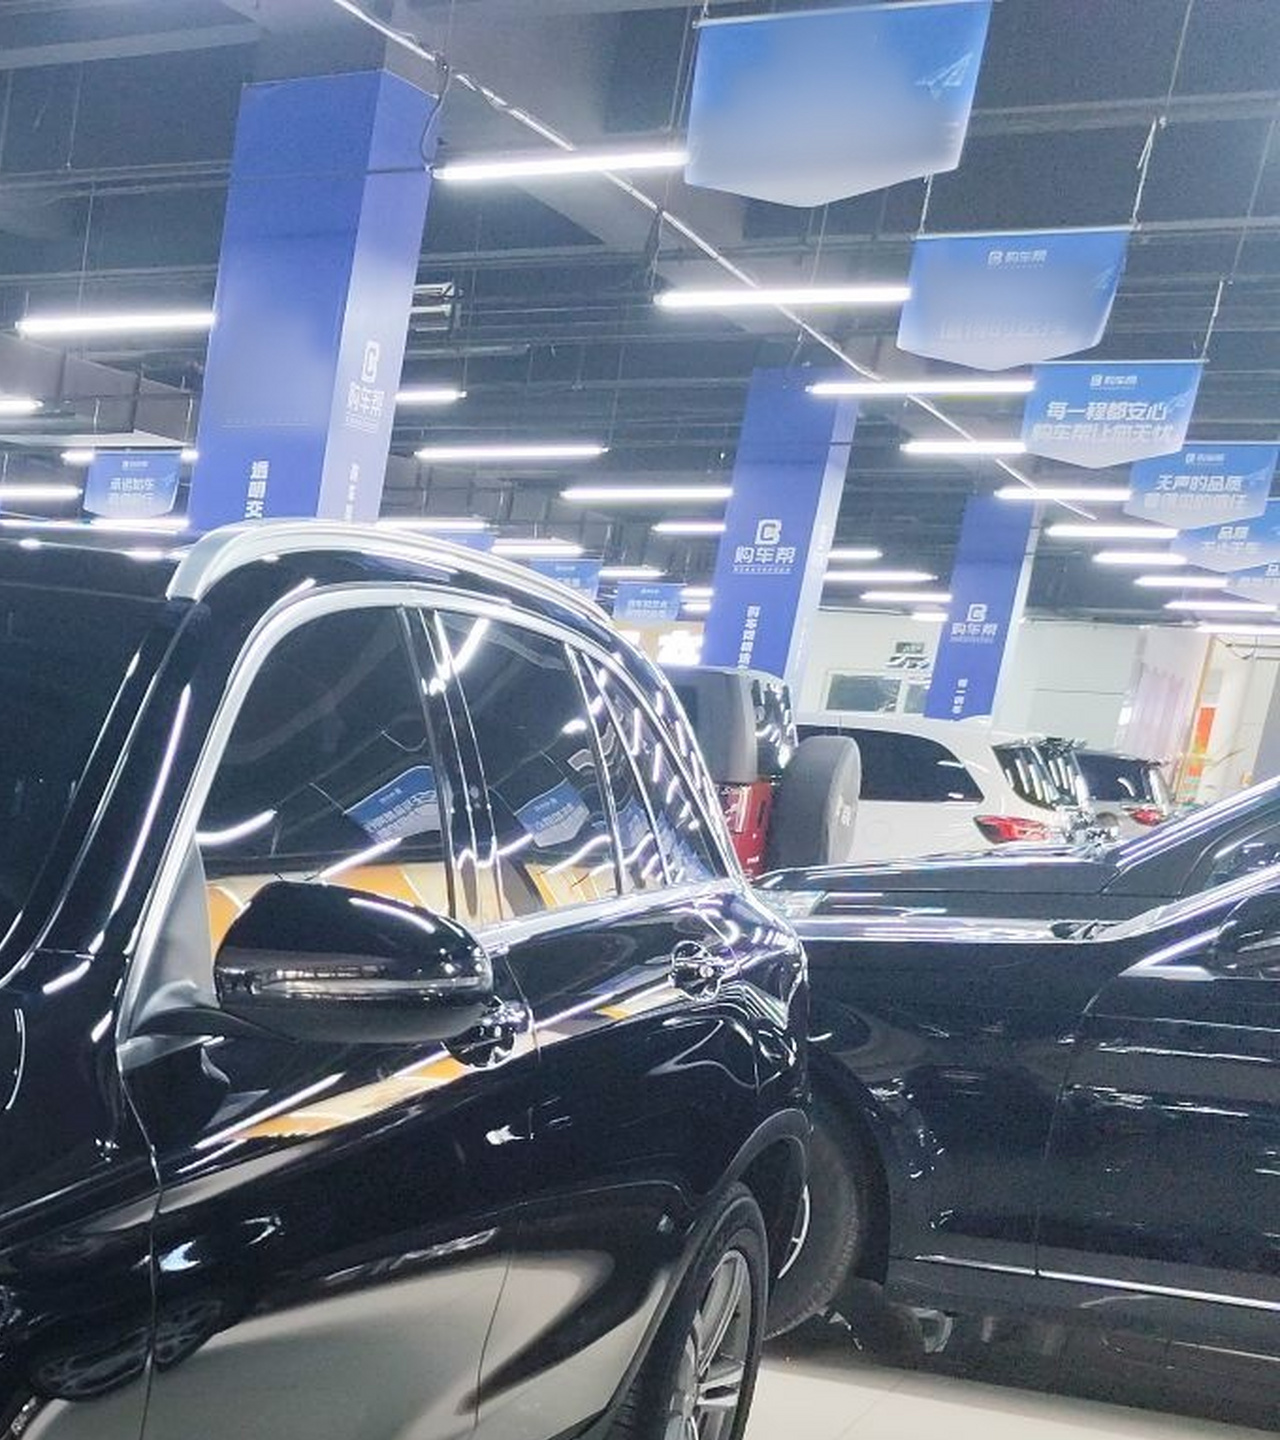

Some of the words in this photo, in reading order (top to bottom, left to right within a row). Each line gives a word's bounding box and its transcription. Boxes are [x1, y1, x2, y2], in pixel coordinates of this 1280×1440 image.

[1046, 401, 1167, 421] 每一程都安心
[734, 546, 796, 563] 购车帮
